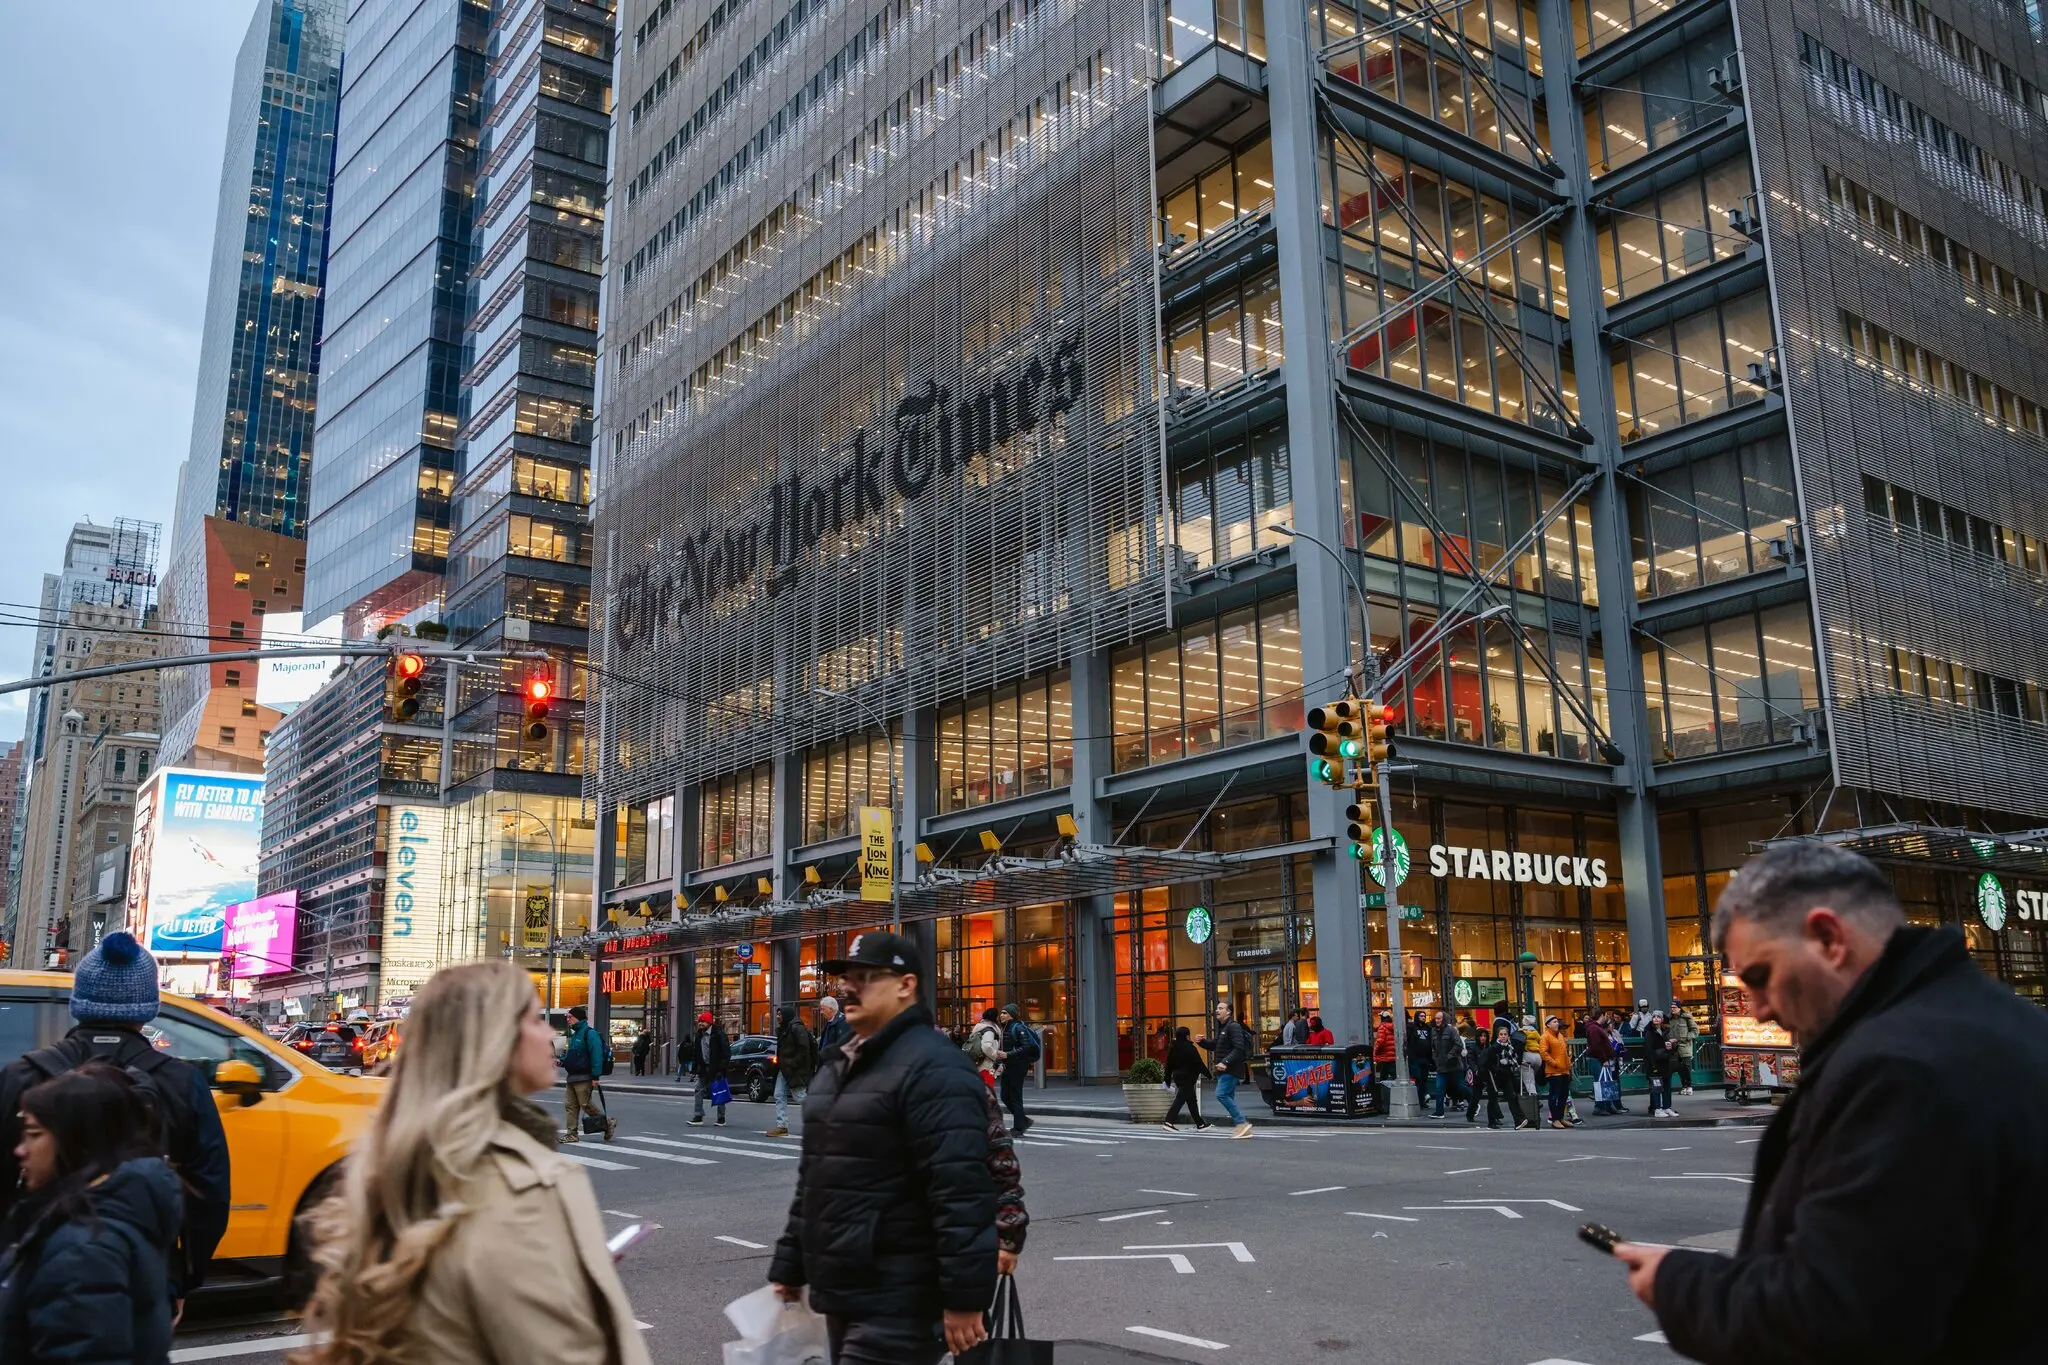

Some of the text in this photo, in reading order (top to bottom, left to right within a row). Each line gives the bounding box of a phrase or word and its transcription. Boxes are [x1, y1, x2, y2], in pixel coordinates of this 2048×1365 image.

[615, 561, 674, 652] The
[766, 428, 884, 597] York
[894, 328, 1084, 500] Times
[176, 783, 194, 800] FLY
[195, 786, 233, 804] BETTER
[236, 789, 249, 805] TO
[174, 802, 257, 822] WITH EMIRATES
[869, 835, 884, 845] THE
[393, 811, 429, 937] eleven
[1429, 844, 1608, 888] STARBUCKS
[1370, 895, 1374, 905] 8
[1410, 907, 1417, 917] 40
[163, 919, 181, 932] FLY
[182, 919, 217, 934] BETTER
[1236, 948, 1271, 958] STARBUCKS
[602, 966, 649, 993] SCHIPPER'S
[1285, 1062, 1334, 1097] AMAZE
